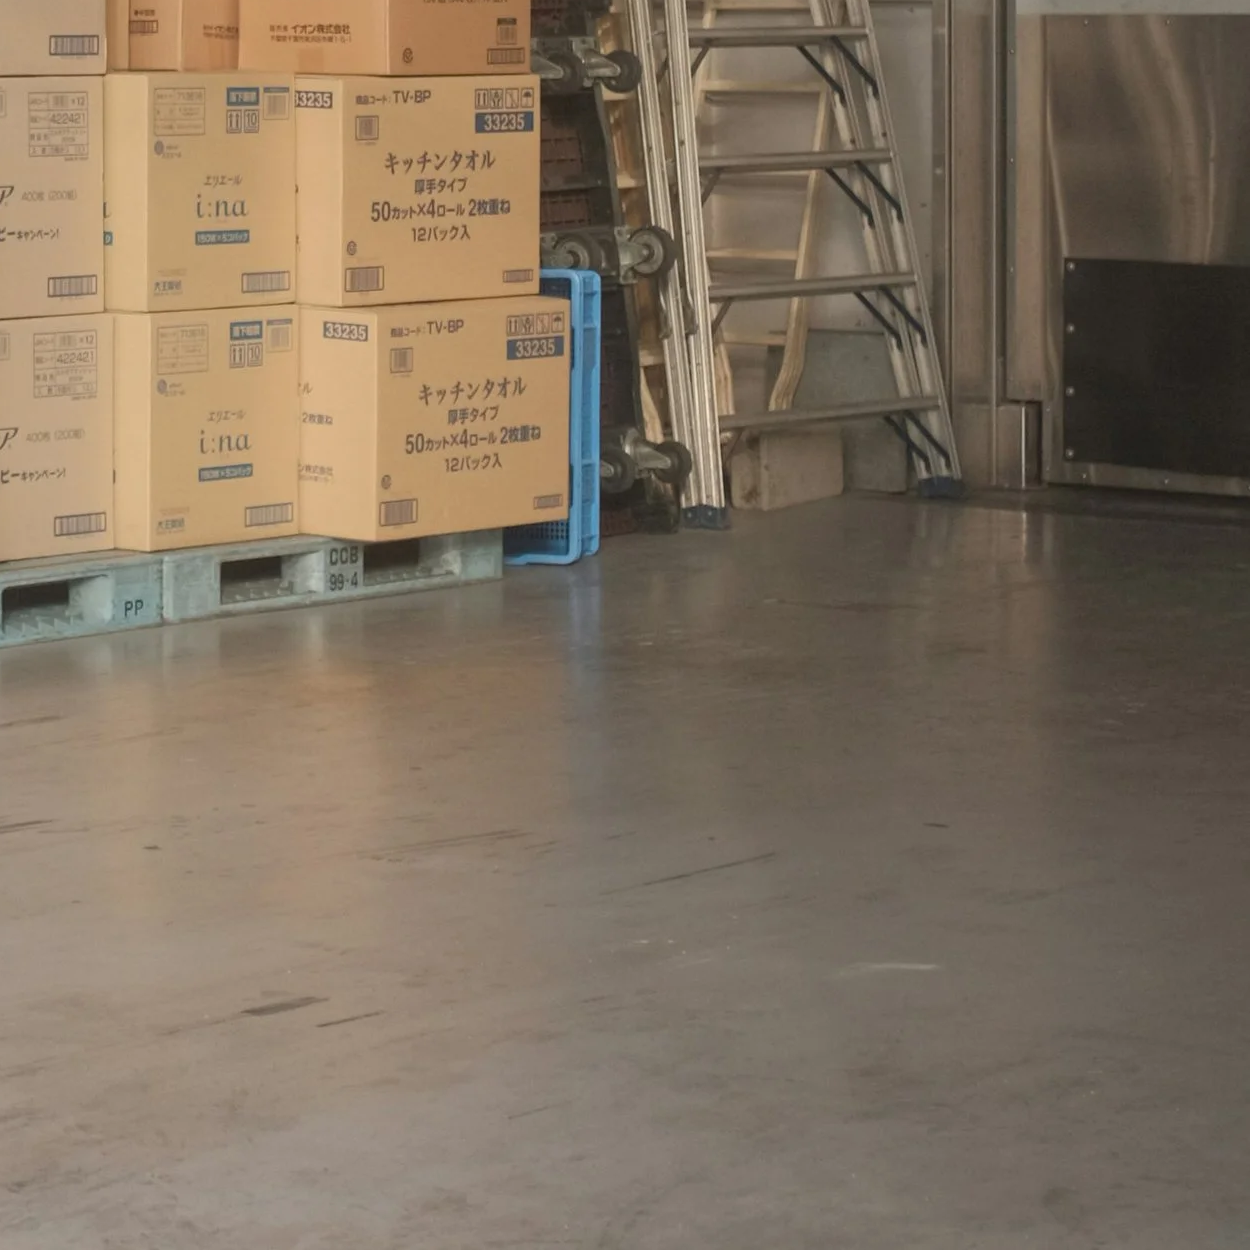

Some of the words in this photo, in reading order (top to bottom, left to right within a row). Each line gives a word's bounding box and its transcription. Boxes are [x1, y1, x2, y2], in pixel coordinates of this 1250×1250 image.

[51, 112, 85, 125] 422421
[484, 114, 525, 131] 33235
[384, 150, 496, 174] キッチンタオル
[414, 178, 467, 194] 厚手タイプ
[196, 194, 248, 218] i:na
[371, 199, 465, 222] 50カット×4ロール
[468, 198, 510, 216] 2枚重ね
[411, 224, 471, 242] 12パック入
[325, 323, 366, 340] 33235
[56, 351, 94, 364] 422421
[515, 339, 555, 357] 33235
[418, 376, 527, 406] キッチンタオル
[448, 405, 499, 425] 厚手タイプ
[200, 430, 252, 454] i:na
[405, 429, 497, 454] 50カット×4ロール
[500, 425, 541, 444] 2枚重ね
[445, 452, 502, 472] 12パック入
[330, 546, 358, 566] CCB
[124, 599, 144, 617] PP
